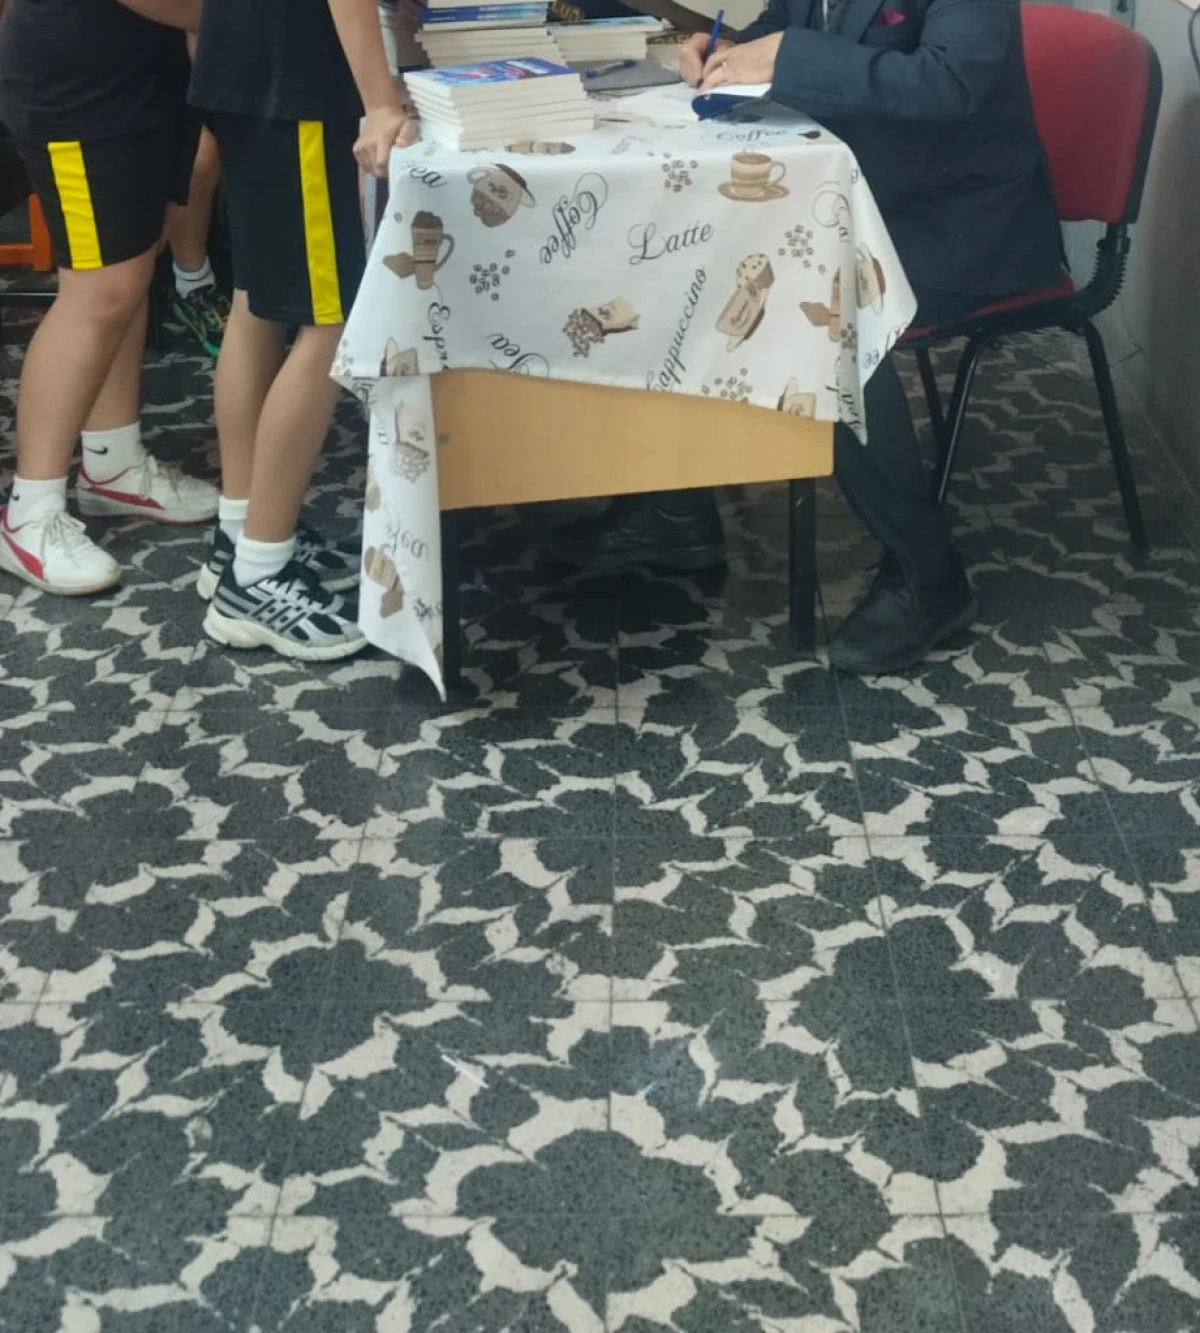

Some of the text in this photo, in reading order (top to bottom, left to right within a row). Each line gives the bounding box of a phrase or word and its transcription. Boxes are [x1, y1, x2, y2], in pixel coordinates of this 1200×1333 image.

[541, 172, 608, 265] Coffee
[627, 221, 714, 266] Latte
[422, 283, 451, 371] Espr
